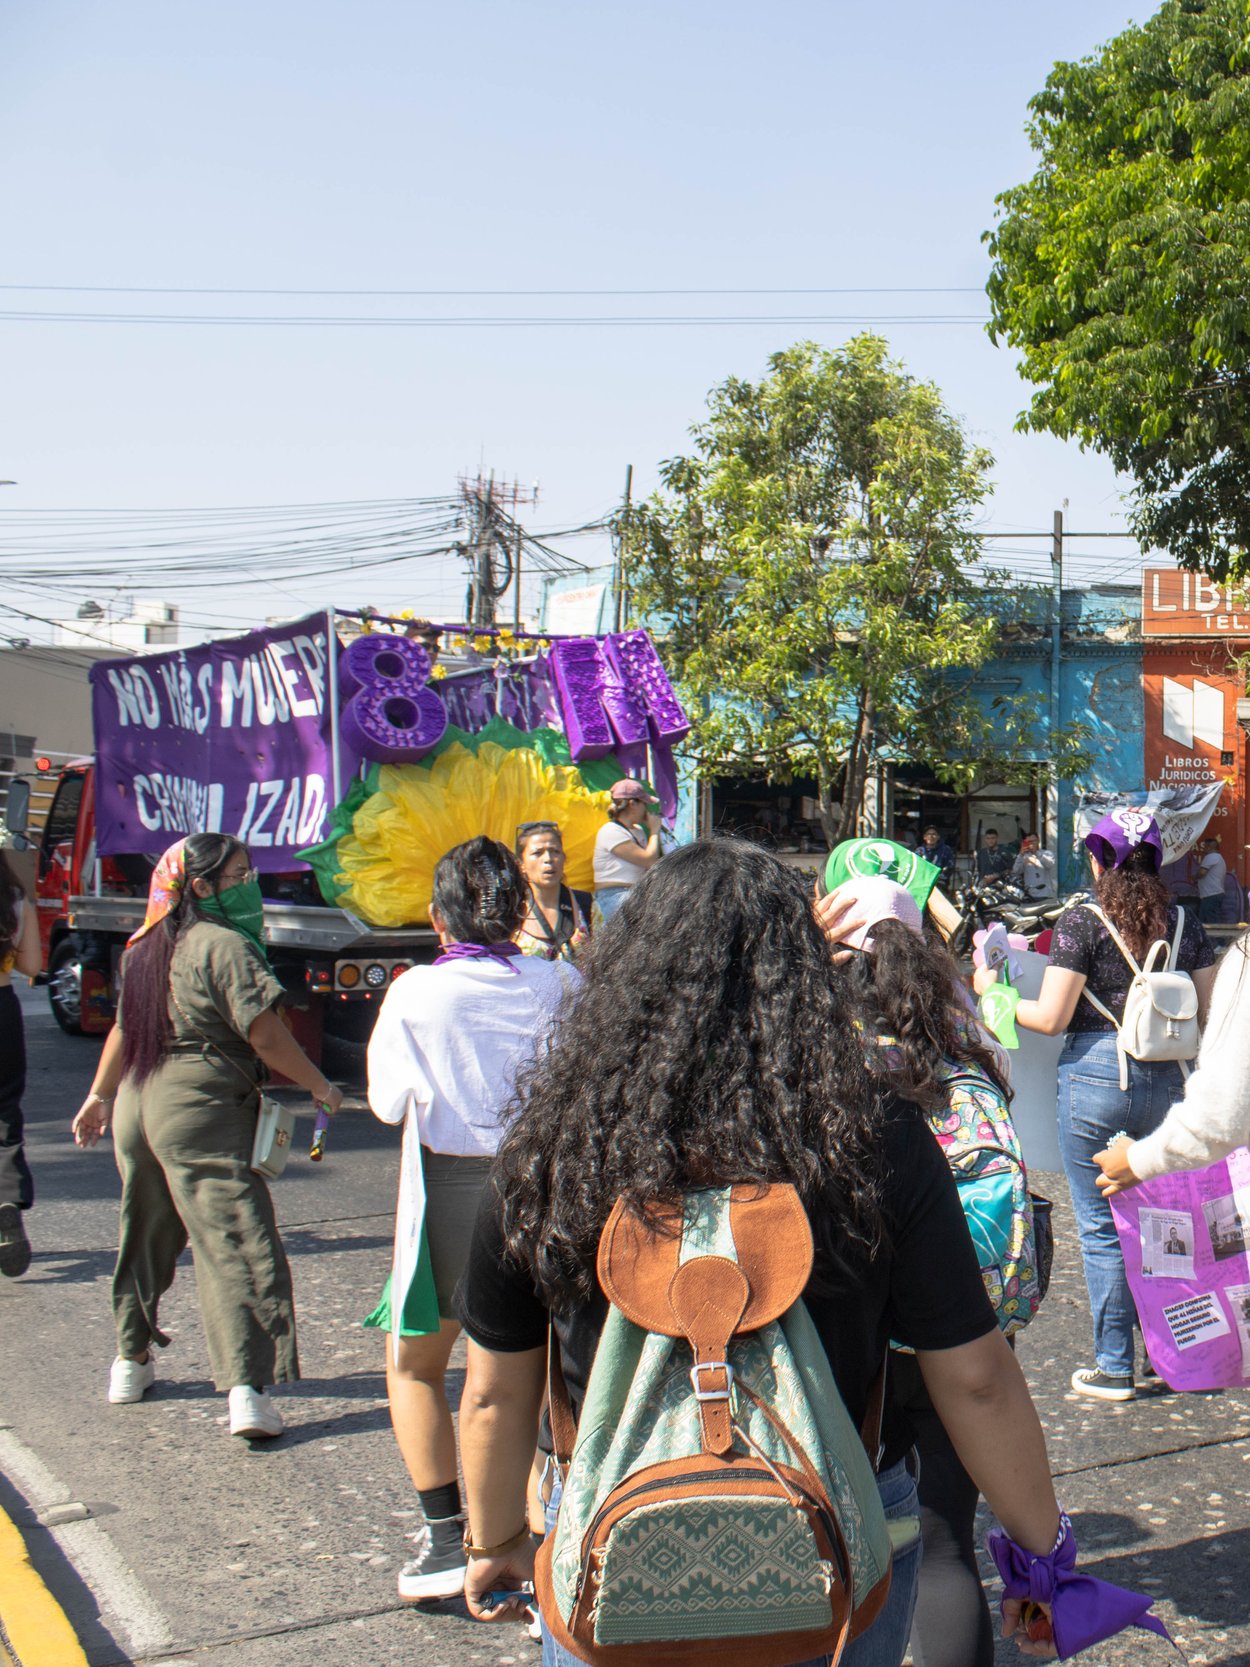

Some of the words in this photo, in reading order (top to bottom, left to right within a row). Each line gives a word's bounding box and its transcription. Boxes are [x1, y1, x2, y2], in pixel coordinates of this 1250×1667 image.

[107, 663, 160, 730] NO
[220, 632, 327, 728] MUJER
[1165, 755, 1209, 768] LIBROS
[1159, 768, 1216, 780] JURIDICOS
